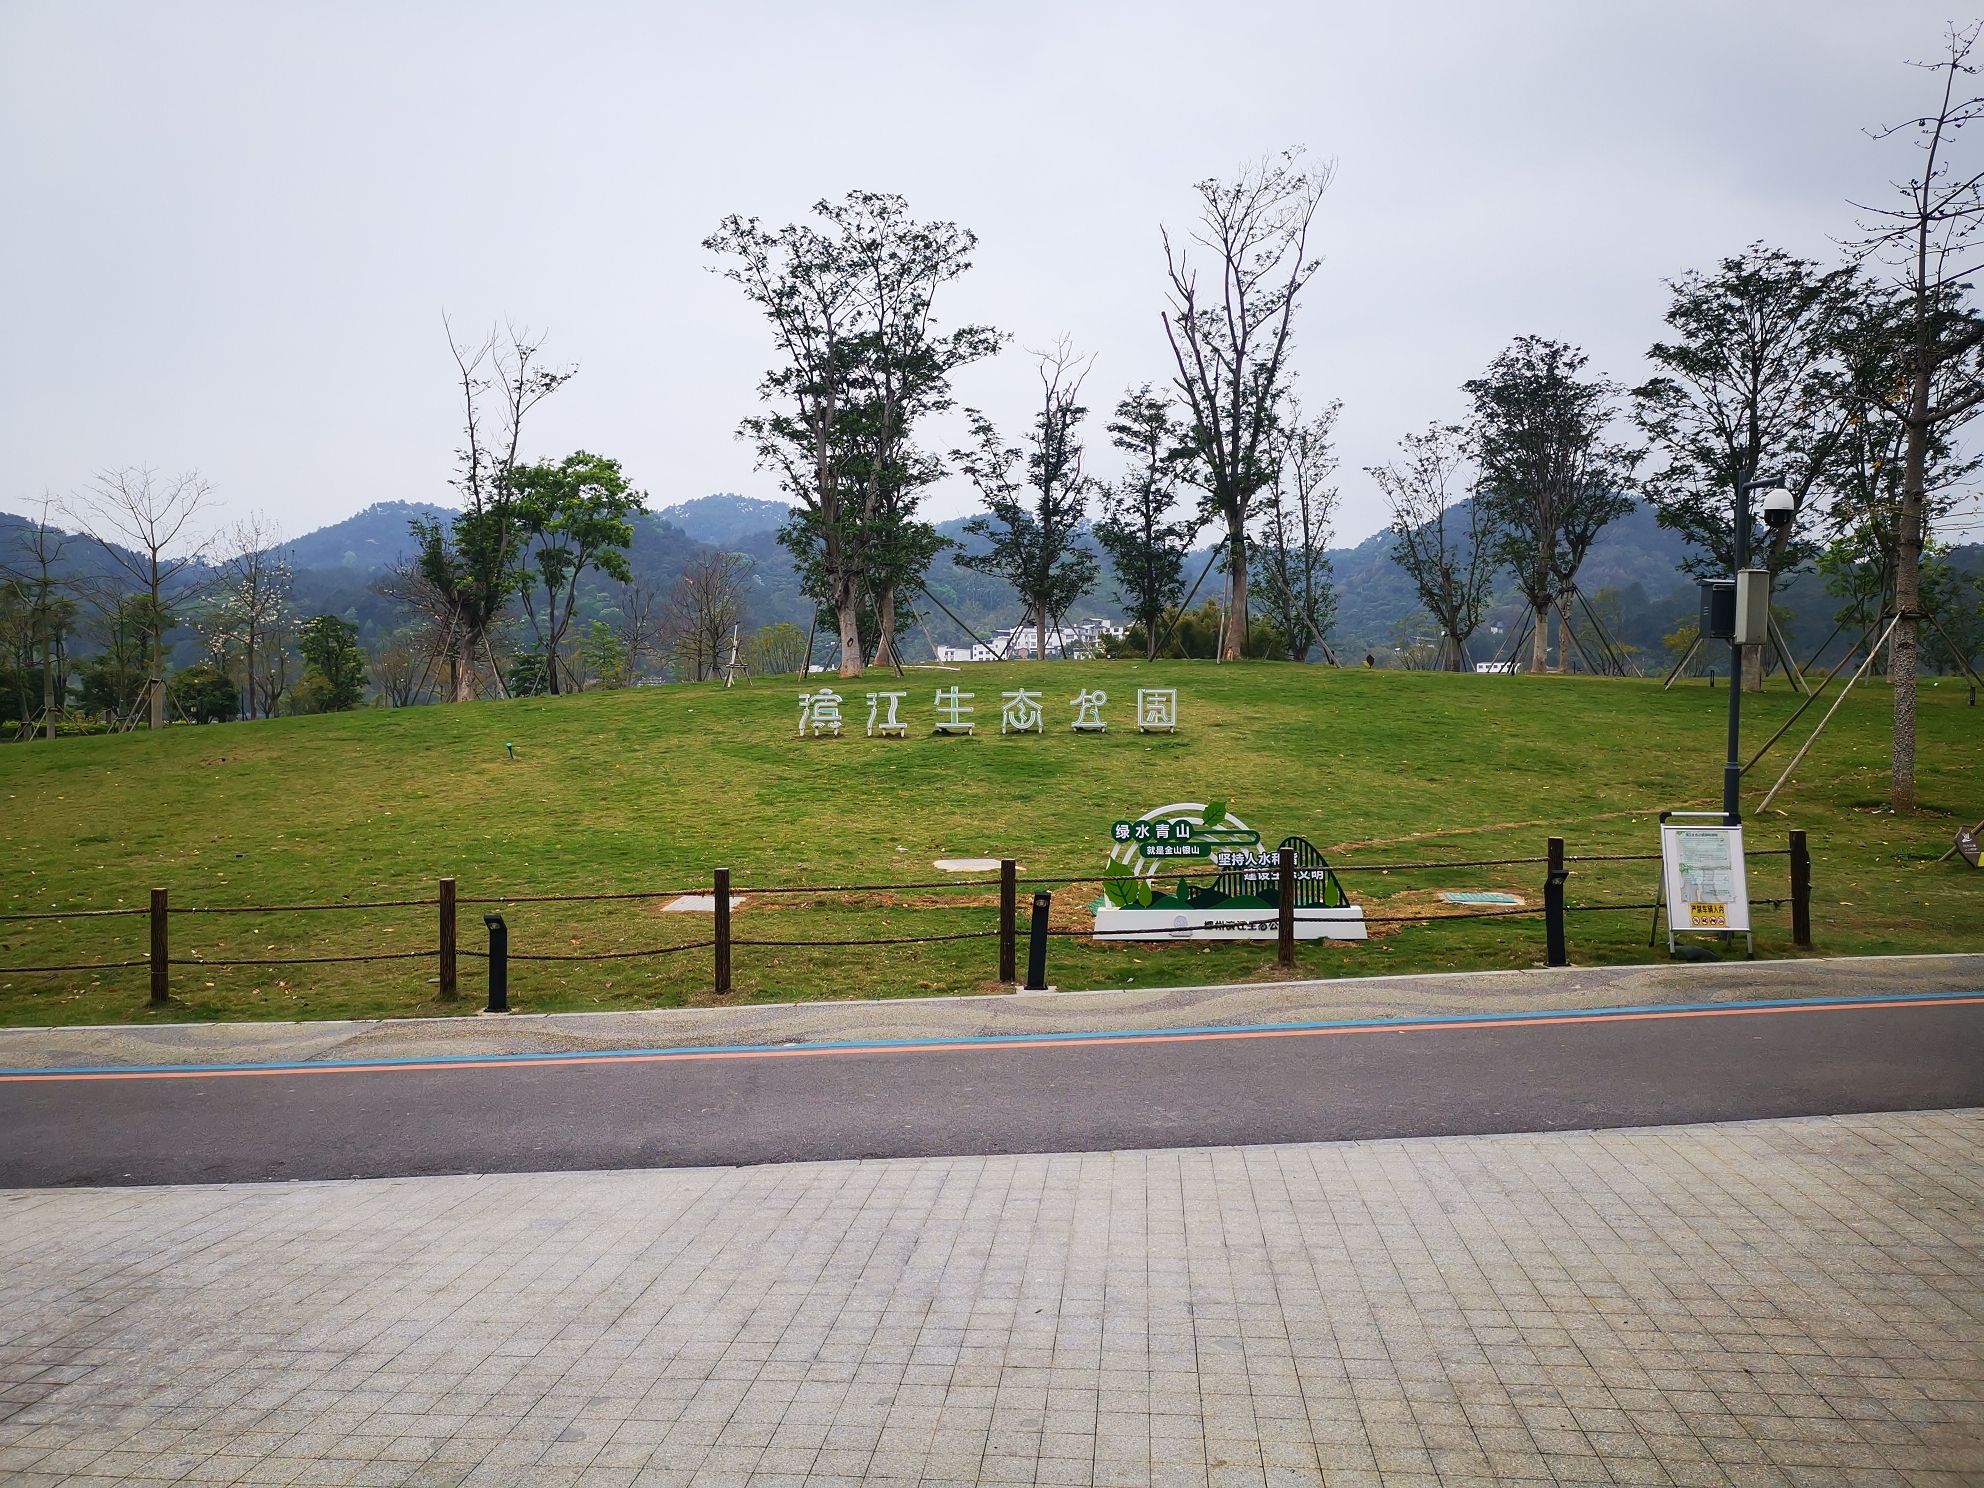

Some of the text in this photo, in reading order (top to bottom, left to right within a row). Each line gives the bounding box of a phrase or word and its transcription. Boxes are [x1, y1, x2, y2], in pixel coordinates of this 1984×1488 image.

[799, 686, 1178, 735] 滨江生态公园
[1115, 823, 1190, 839] 绿水青山
[1146, 845, 1200, 855] 就是金山银山
[1218, 852, 1298, 866] 坚持人水和
[1243, 868, 1324, 881] 建设文明
